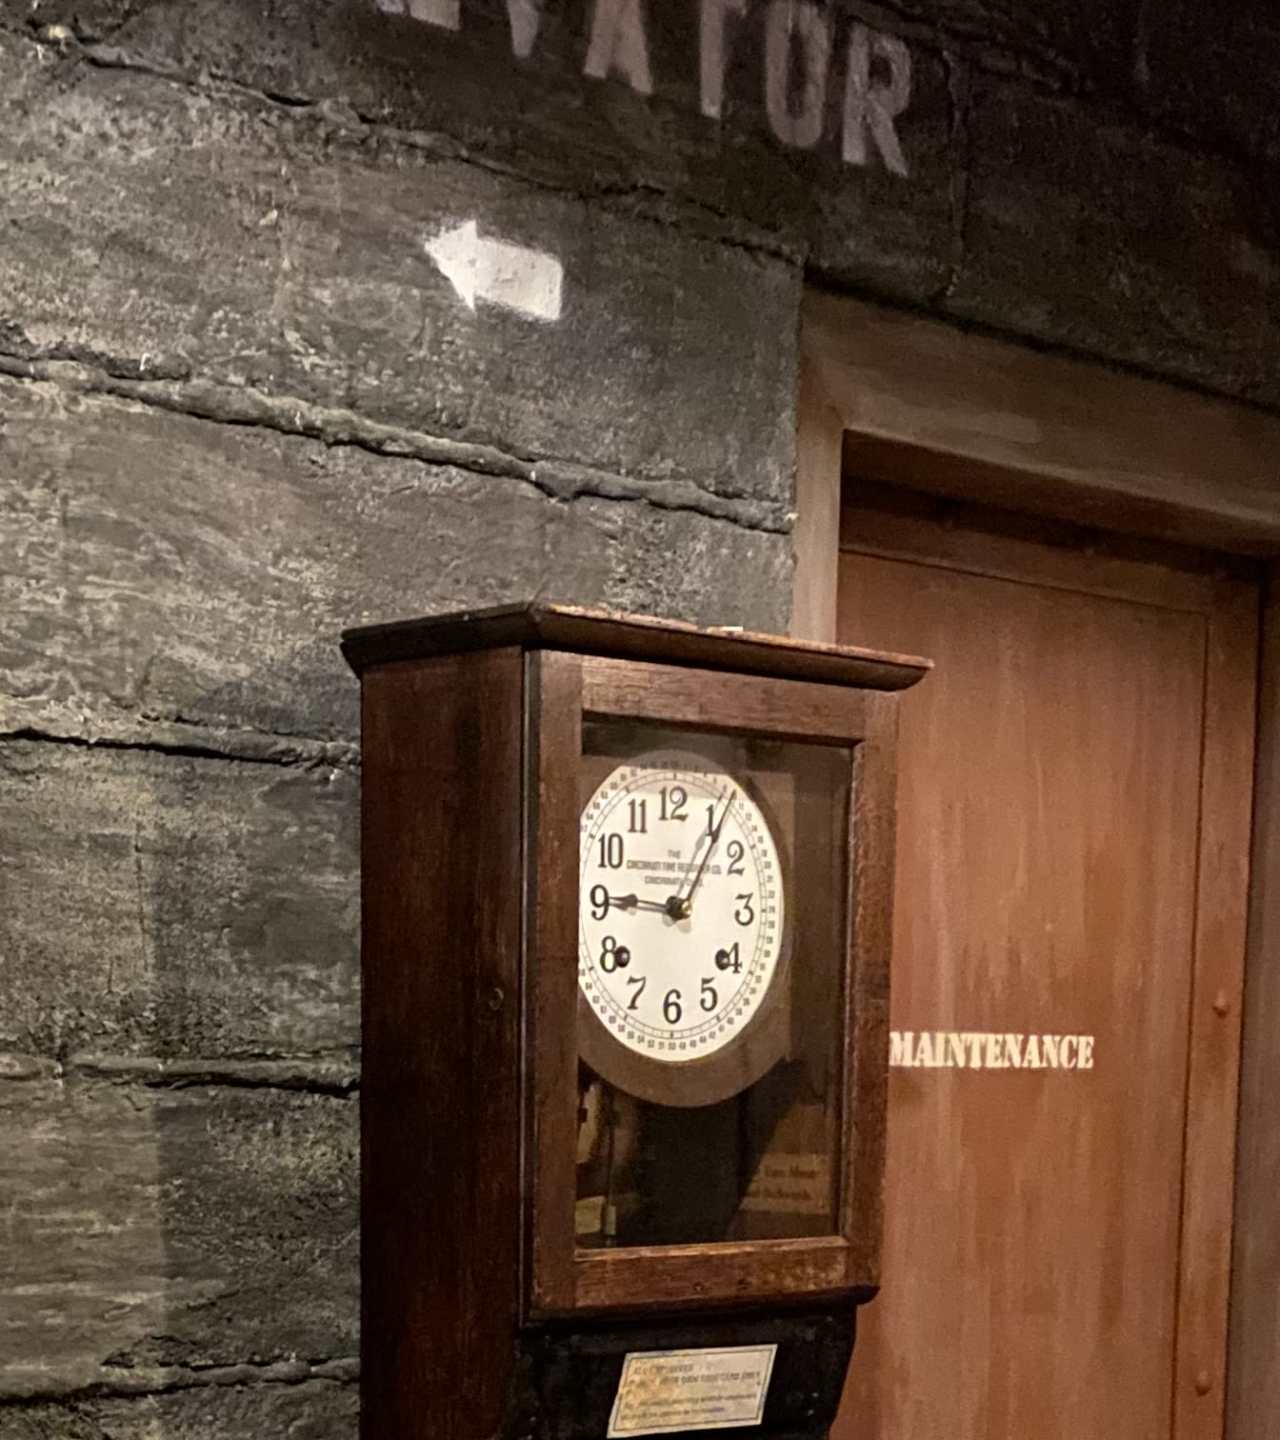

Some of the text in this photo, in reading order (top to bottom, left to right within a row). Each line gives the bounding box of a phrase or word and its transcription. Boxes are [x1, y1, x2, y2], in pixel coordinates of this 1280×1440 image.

[628, 798, 648, 833] 11
[658, 786, 689, 822] 12
[705, 804, 716, 837] 1
[598, 833, 623, 869] 10
[726, 840, 746, 876] 2
[589, 884, 610, 921] 9
[734, 893, 754, 926] 3
[599, 935, 617, 973] 8
[724, 942, 743, 973] 4
[626, 976, 647, 1010] 7
[663, 988, 683, 1024] 6
[699, 976, 718, 1012] 5
[889, 1031, 1095, 1070] MAINTENANCE
